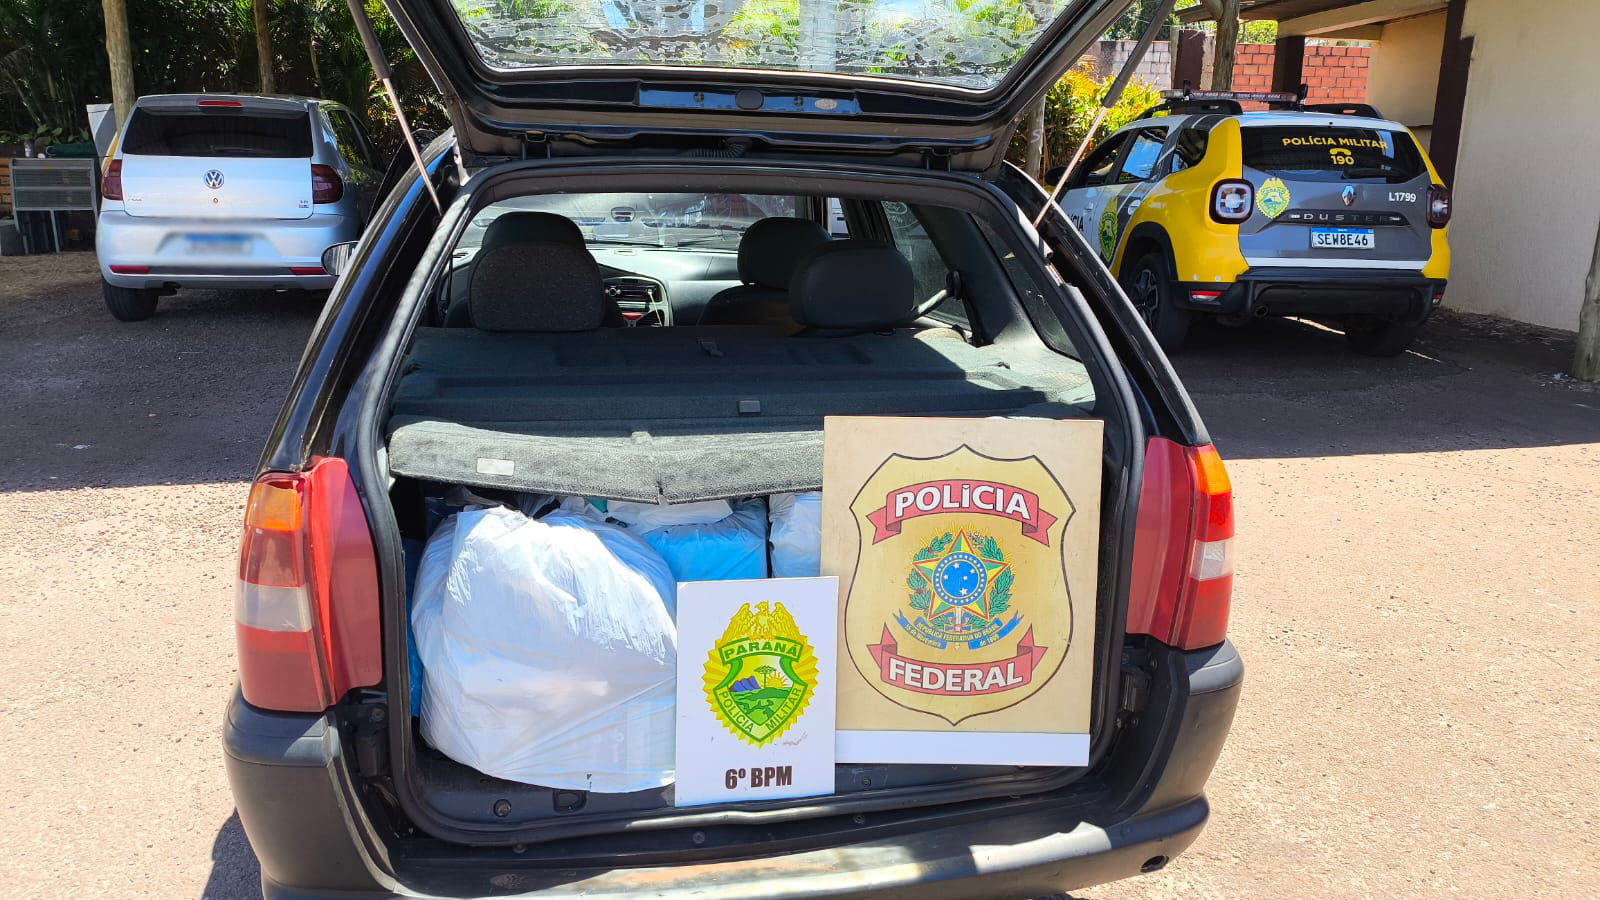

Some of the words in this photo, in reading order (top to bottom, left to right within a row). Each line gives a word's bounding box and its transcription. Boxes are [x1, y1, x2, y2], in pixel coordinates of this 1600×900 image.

[1282, 135, 1336, 146] POLÍCIA
[1339, 138, 1388, 149] MILITAR
[1330, 155, 1355, 165] 190
[1388, 192, 1416, 202] L1799
[1303, 213, 1389, 221] DUSTER
[1317, 233, 1369, 246] SEW8E46
[724, 641, 798, 660] PARANÁ
[888, 659, 1023, 691] FEDERAL
[765, 687, 802, 731] MILITAR
[750, 765, 793, 788] BPM
